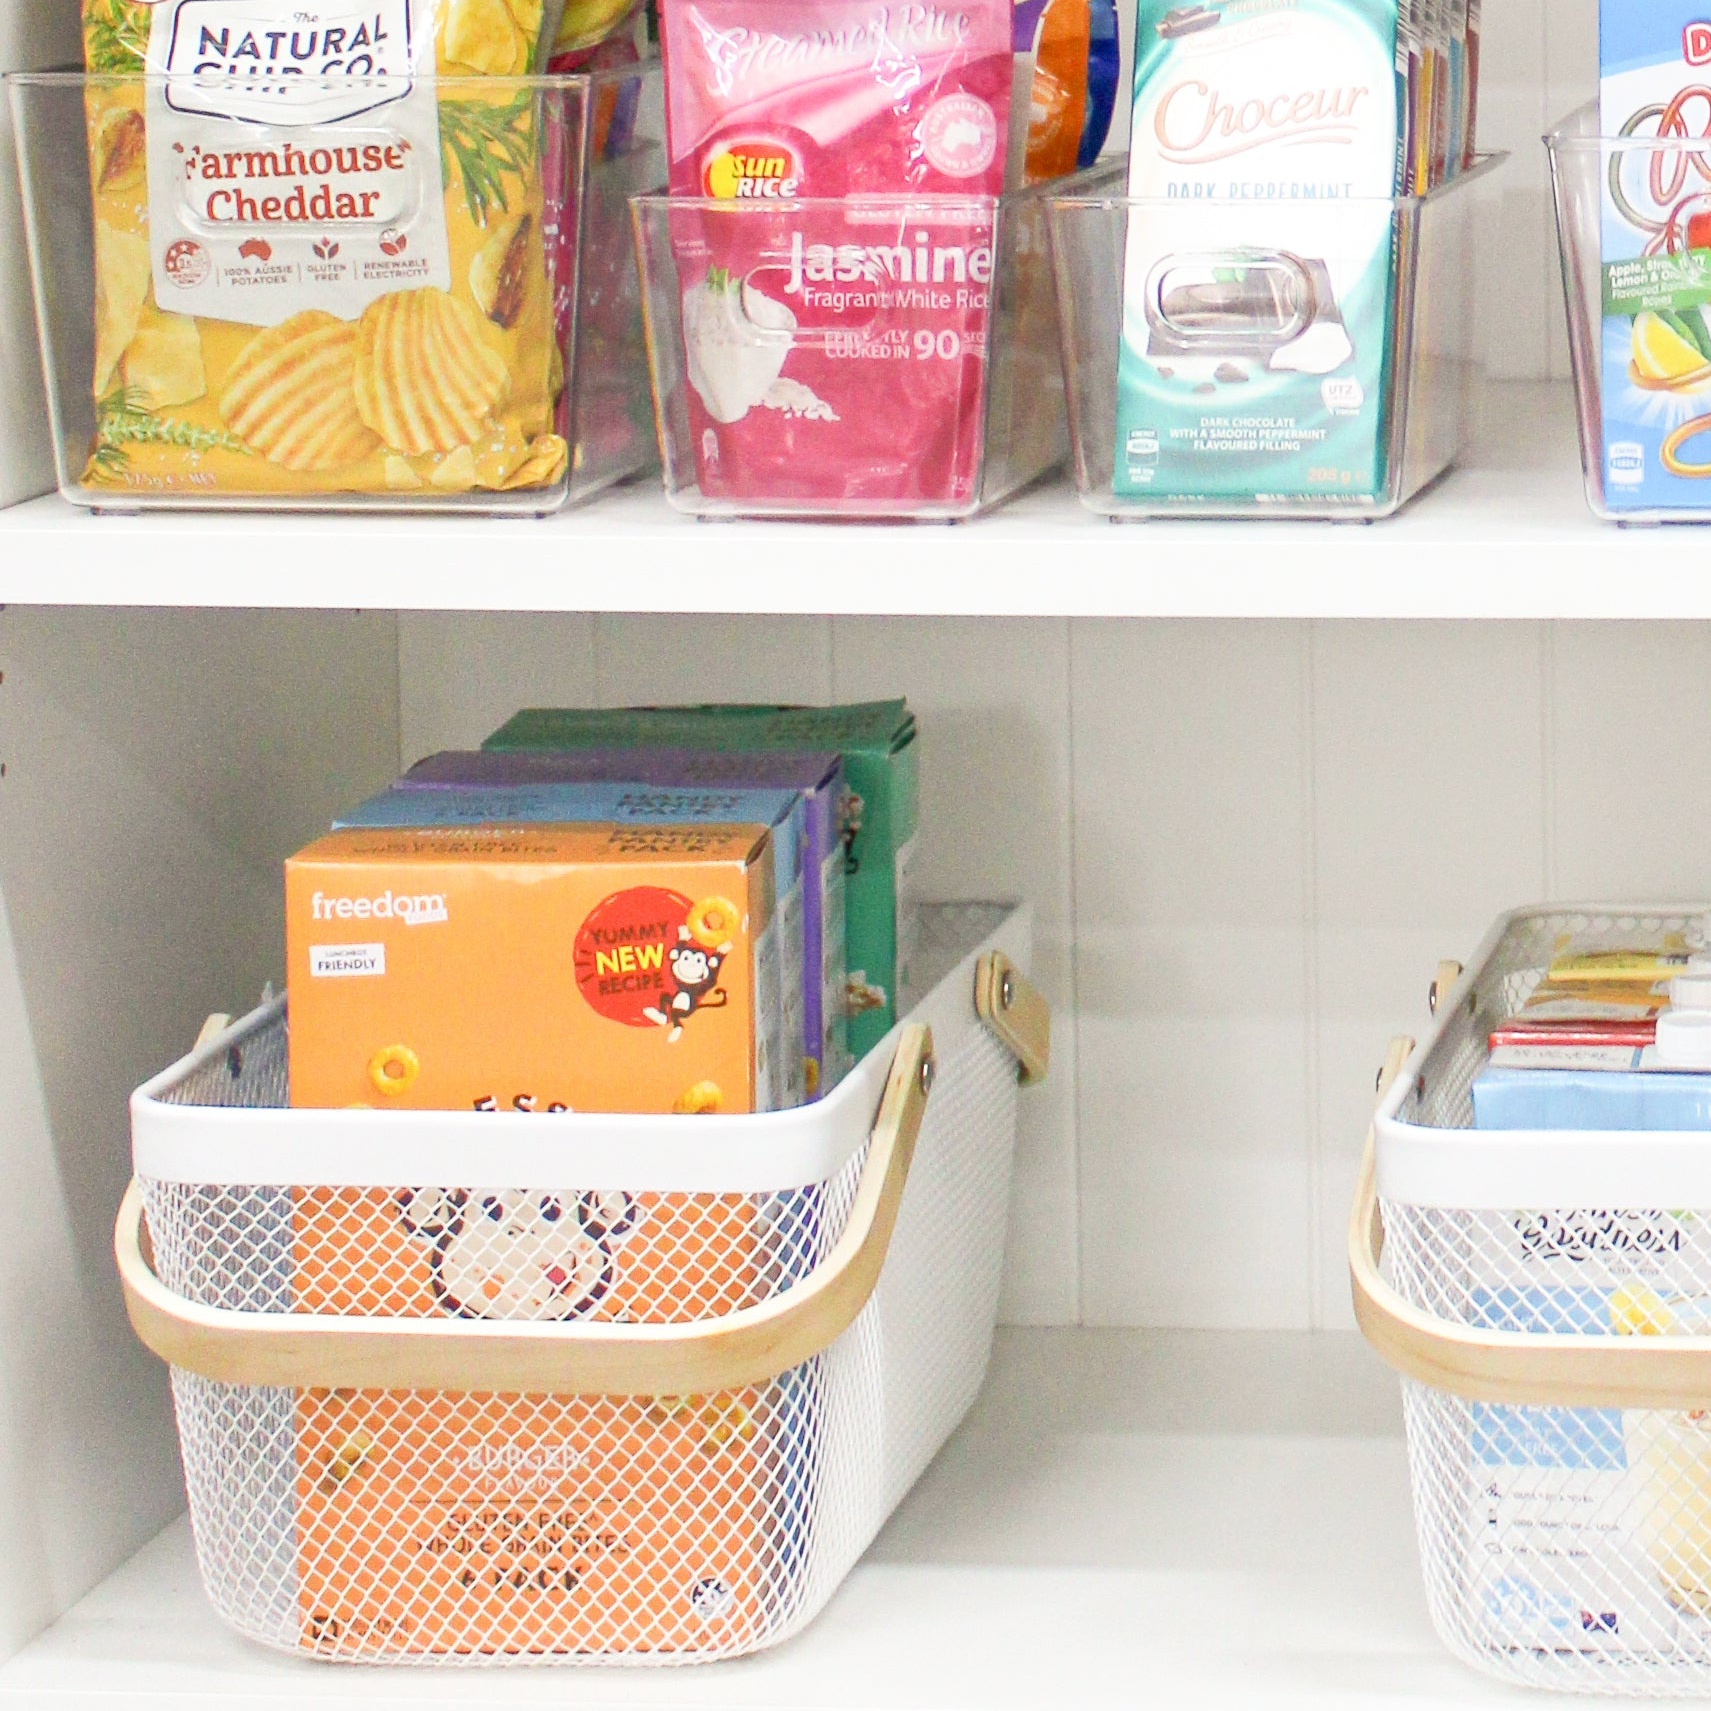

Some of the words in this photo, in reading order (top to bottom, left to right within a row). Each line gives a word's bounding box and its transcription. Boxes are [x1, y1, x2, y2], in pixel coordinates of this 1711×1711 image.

[293, 12, 320, 24] The
[901, 3, 970, 47] Rice
[199, 13, 389, 61] NATURAL
[1154, 79, 1369, 151] Choceur
[207, 184, 380, 222] Cheddar
[307, 263, 347, 273] GLUTEN
[364, 259, 429, 270] RENEWABLE
[783, 231, 992, 293] Jasmine
[1608, 262, 1644, 278] Apple,
[224, 266, 250, 277] 100%
[255, 265, 293, 275] AUSSIE
[315, 273, 340, 282] FREE
[364, 268, 430, 279] ELECTRICITY
[231, 275, 288, 286] POTATOES
[1611, 274, 1649, 288] Lemon
[1650, 271, 1659, 283] &
[803, 287, 889, 314] Fragrant
[893, 345, 910, 359] IN
[914, 329, 960, 361] 90
[1328, 384, 1353, 396] UTZ
[1200, 417, 1230, 429] DARK
[1232, 417, 1296, 429] CHOCOLATE
[1170, 428, 1198, 439] WITH
[1200, 428, 1208, 439] A
[1210, 429, 1257, 440] SMOOTH
[1259, 429, 1326, 441] PEPPERMINT
[1193, 440, 1258, 452] FLAVOURED
[1259, 440, 1301, 452] FILLING
[311, 889, 447, 921] freedom
[590, 921, 669, 945] YUMMY
[317, 958, 377, 972] FRIENDLY
[595, 942, 665, 976] NEW
[598, 972, 664, 995] RECIPE
